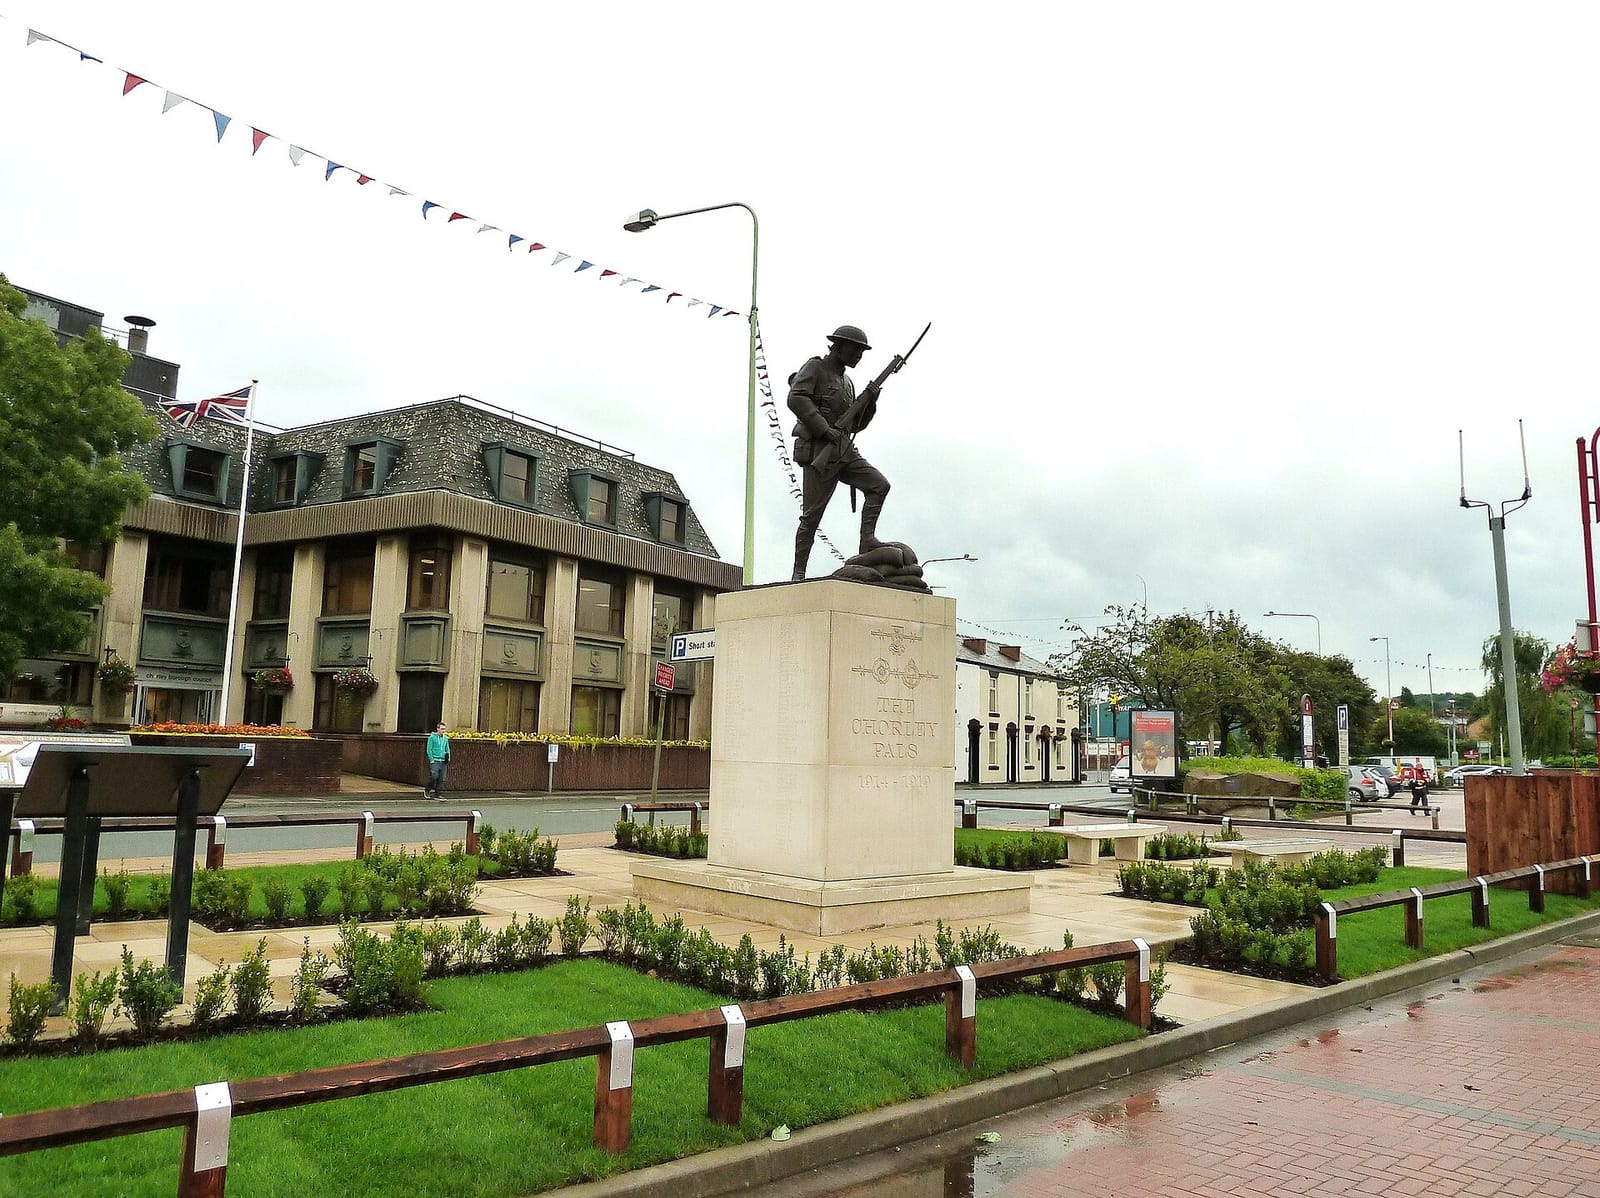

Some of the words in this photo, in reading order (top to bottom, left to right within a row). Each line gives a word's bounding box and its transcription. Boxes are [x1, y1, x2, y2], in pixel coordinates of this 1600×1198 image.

[675, 639, 684, 656] P
[689, 641, 705, 650] Short
[877, 697, 915, 714] THE
[851, 718, 939, 737] CHORLEY
[873, 742, 918, 759] PALS
[858, 775, 889, 788] 1914
